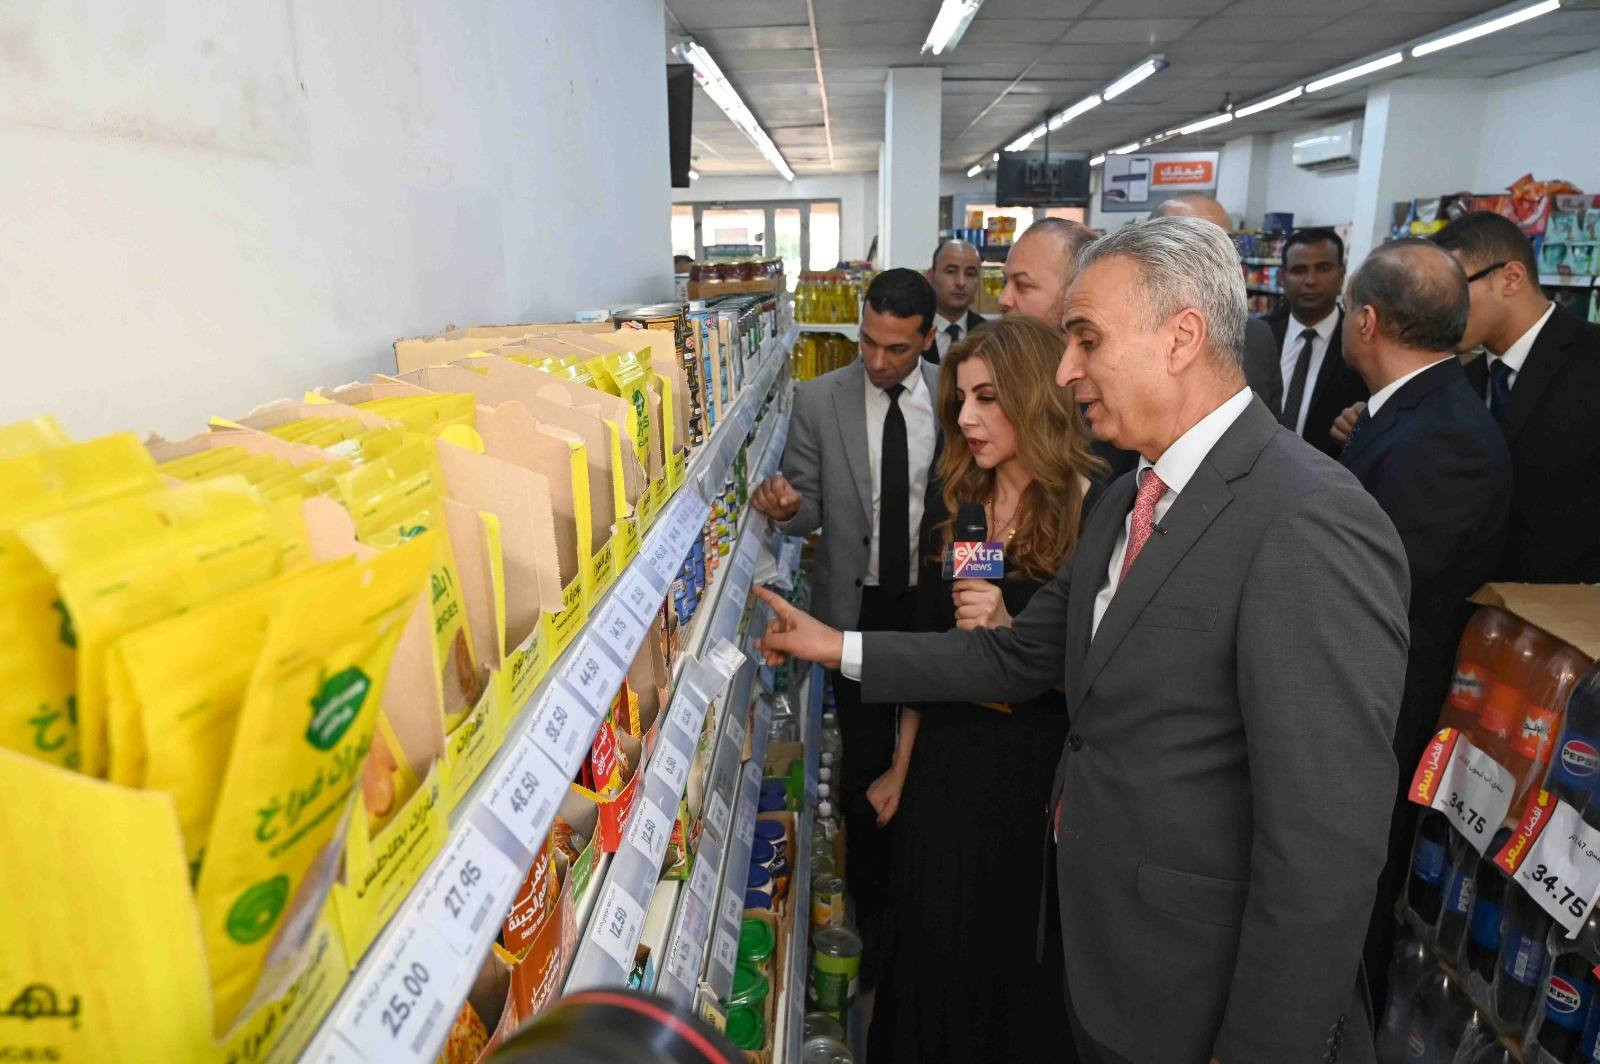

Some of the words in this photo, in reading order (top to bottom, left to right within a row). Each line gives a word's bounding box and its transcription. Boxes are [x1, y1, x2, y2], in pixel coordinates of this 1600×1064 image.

[965, 563, 992, 571] news
[579, 657, 600, 687] 44.50
[545, 705, 568, 744] 38.50
[509, 771, 540, 815] 48.50
[641, 819, 656, 844] 12.50
[1449, 792, 1486, 834] 34.75
[444, 859, 481, 919] 27.95
[1532, 863, 1588, 918] 34.75
[609, 906, 627, 939] 12.50
[381, 962, 430, 1039] 25.00
[1548, 985, 1579, 1007] EPSI
